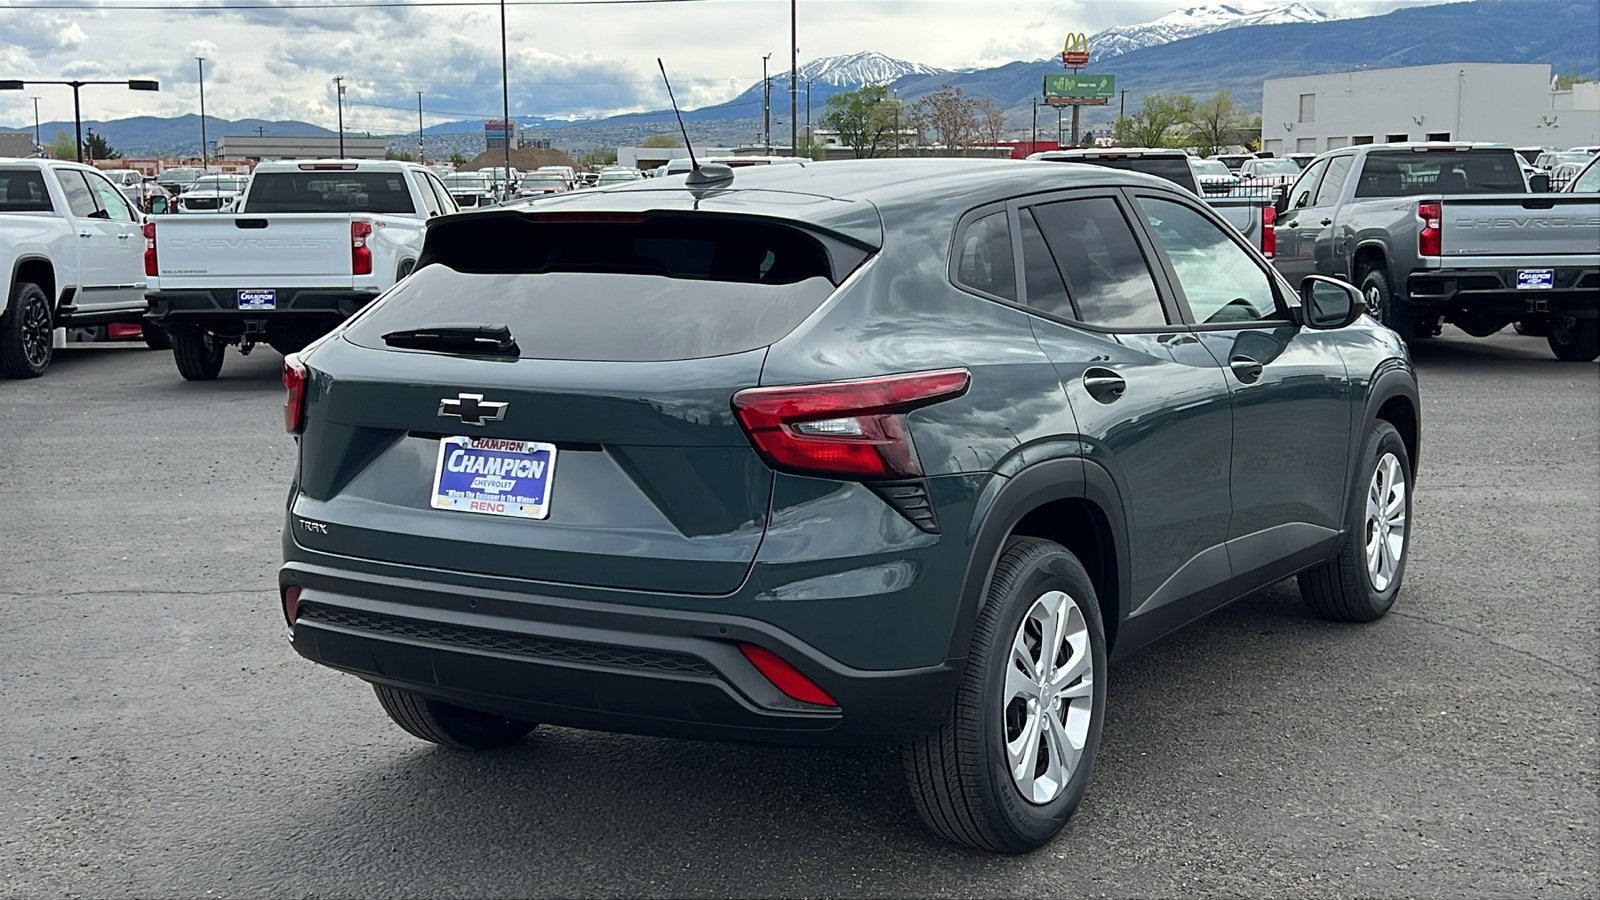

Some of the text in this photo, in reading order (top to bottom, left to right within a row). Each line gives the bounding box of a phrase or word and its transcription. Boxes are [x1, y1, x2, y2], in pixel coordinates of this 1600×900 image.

[170, 238, 337, 249] CHEVROLET
[471, 439, 524, 452] CHAMPION
[447, 449, 545, 479] CHAMPION
[474, 479, 512, 488] CHEVROLET
[470, 501, 505, 512] RENO
[299, 519, 328, 534] TRAX
